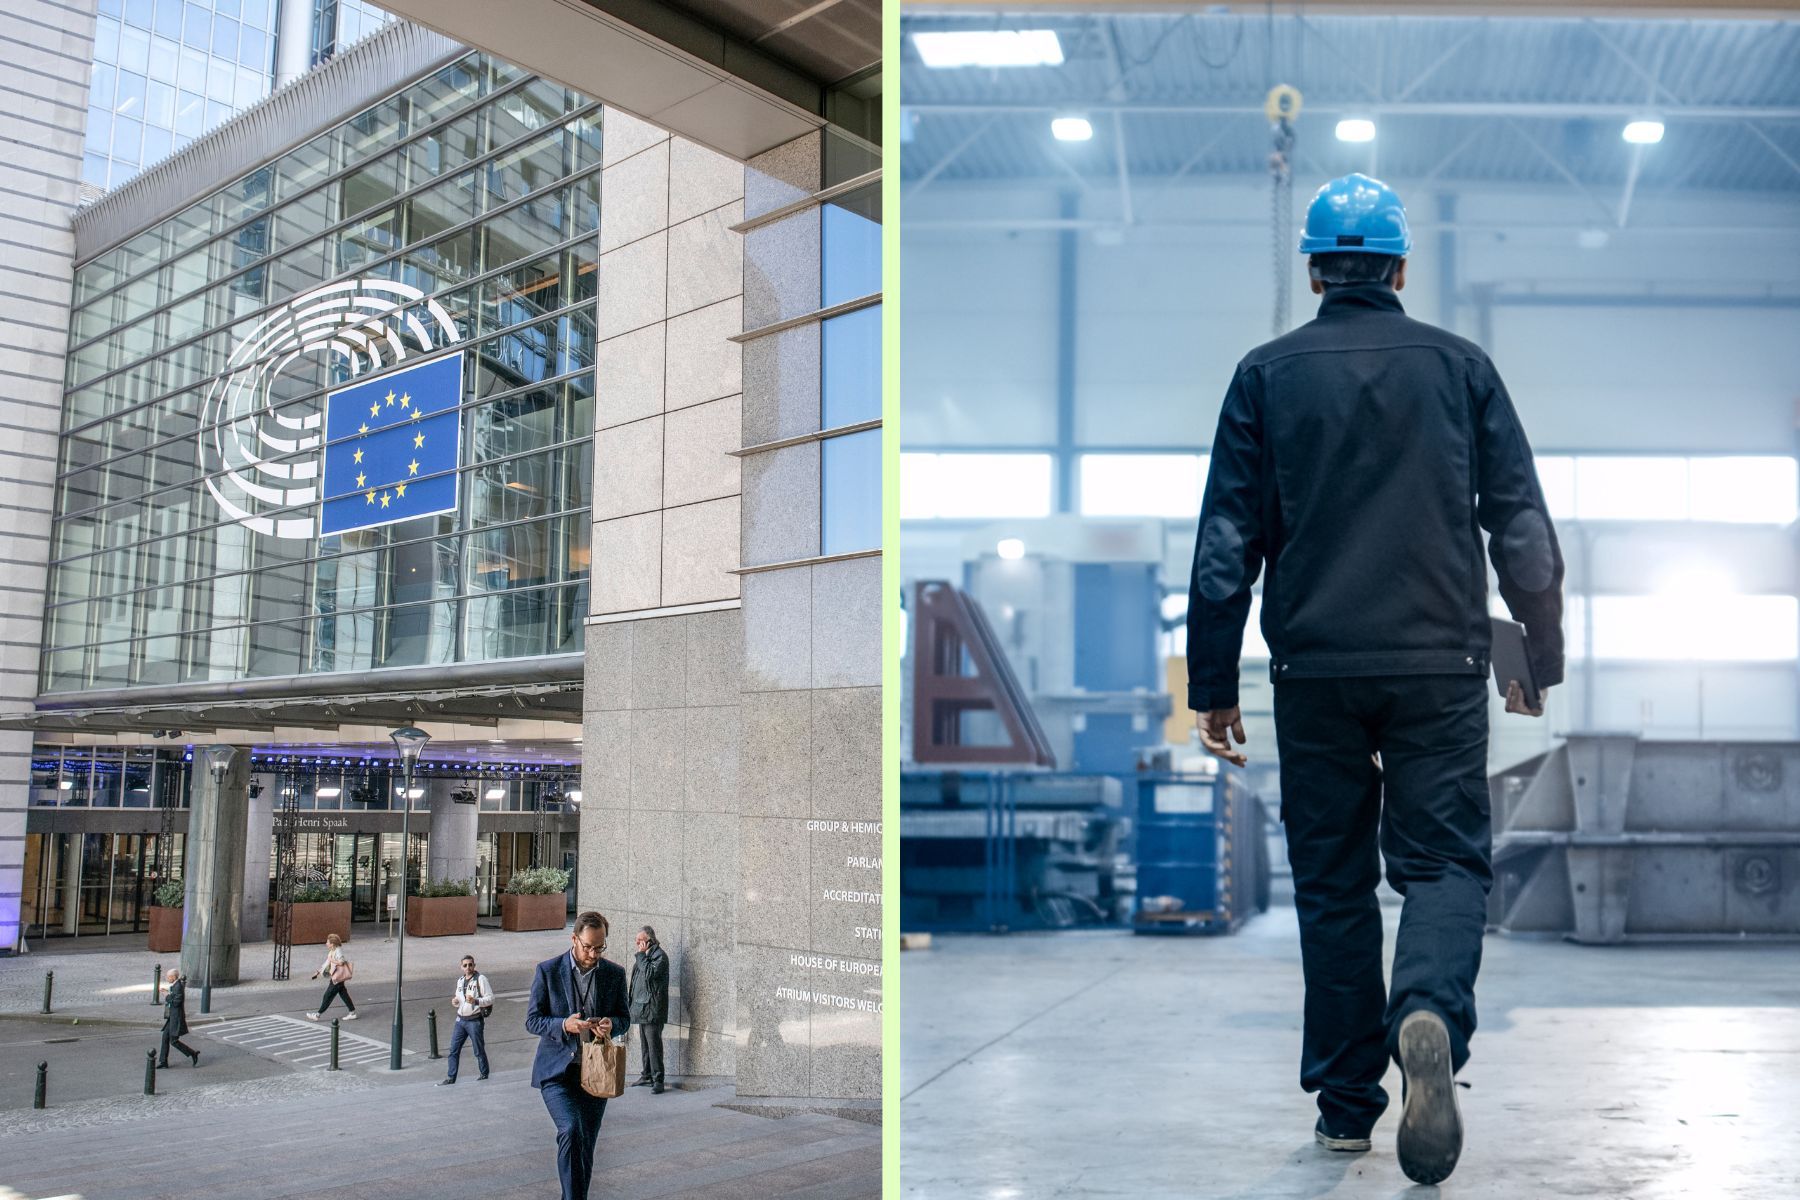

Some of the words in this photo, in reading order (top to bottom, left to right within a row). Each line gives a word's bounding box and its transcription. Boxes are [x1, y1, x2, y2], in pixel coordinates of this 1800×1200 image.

[322, 817, 348, 830] Spaak
[807, 820, 840, 832] GROUP
[841, 821, 849, 833] &
[851, 822, 883, 834] HEMIC
[854, 926, 883, 941] STATI
[790, 955, 823, 969] HOUSE
[824, 959, 838, 970] OF
[776, 986, 811, 1002] ATRIUM
[812, 992, 856, 1009] VISITORS
